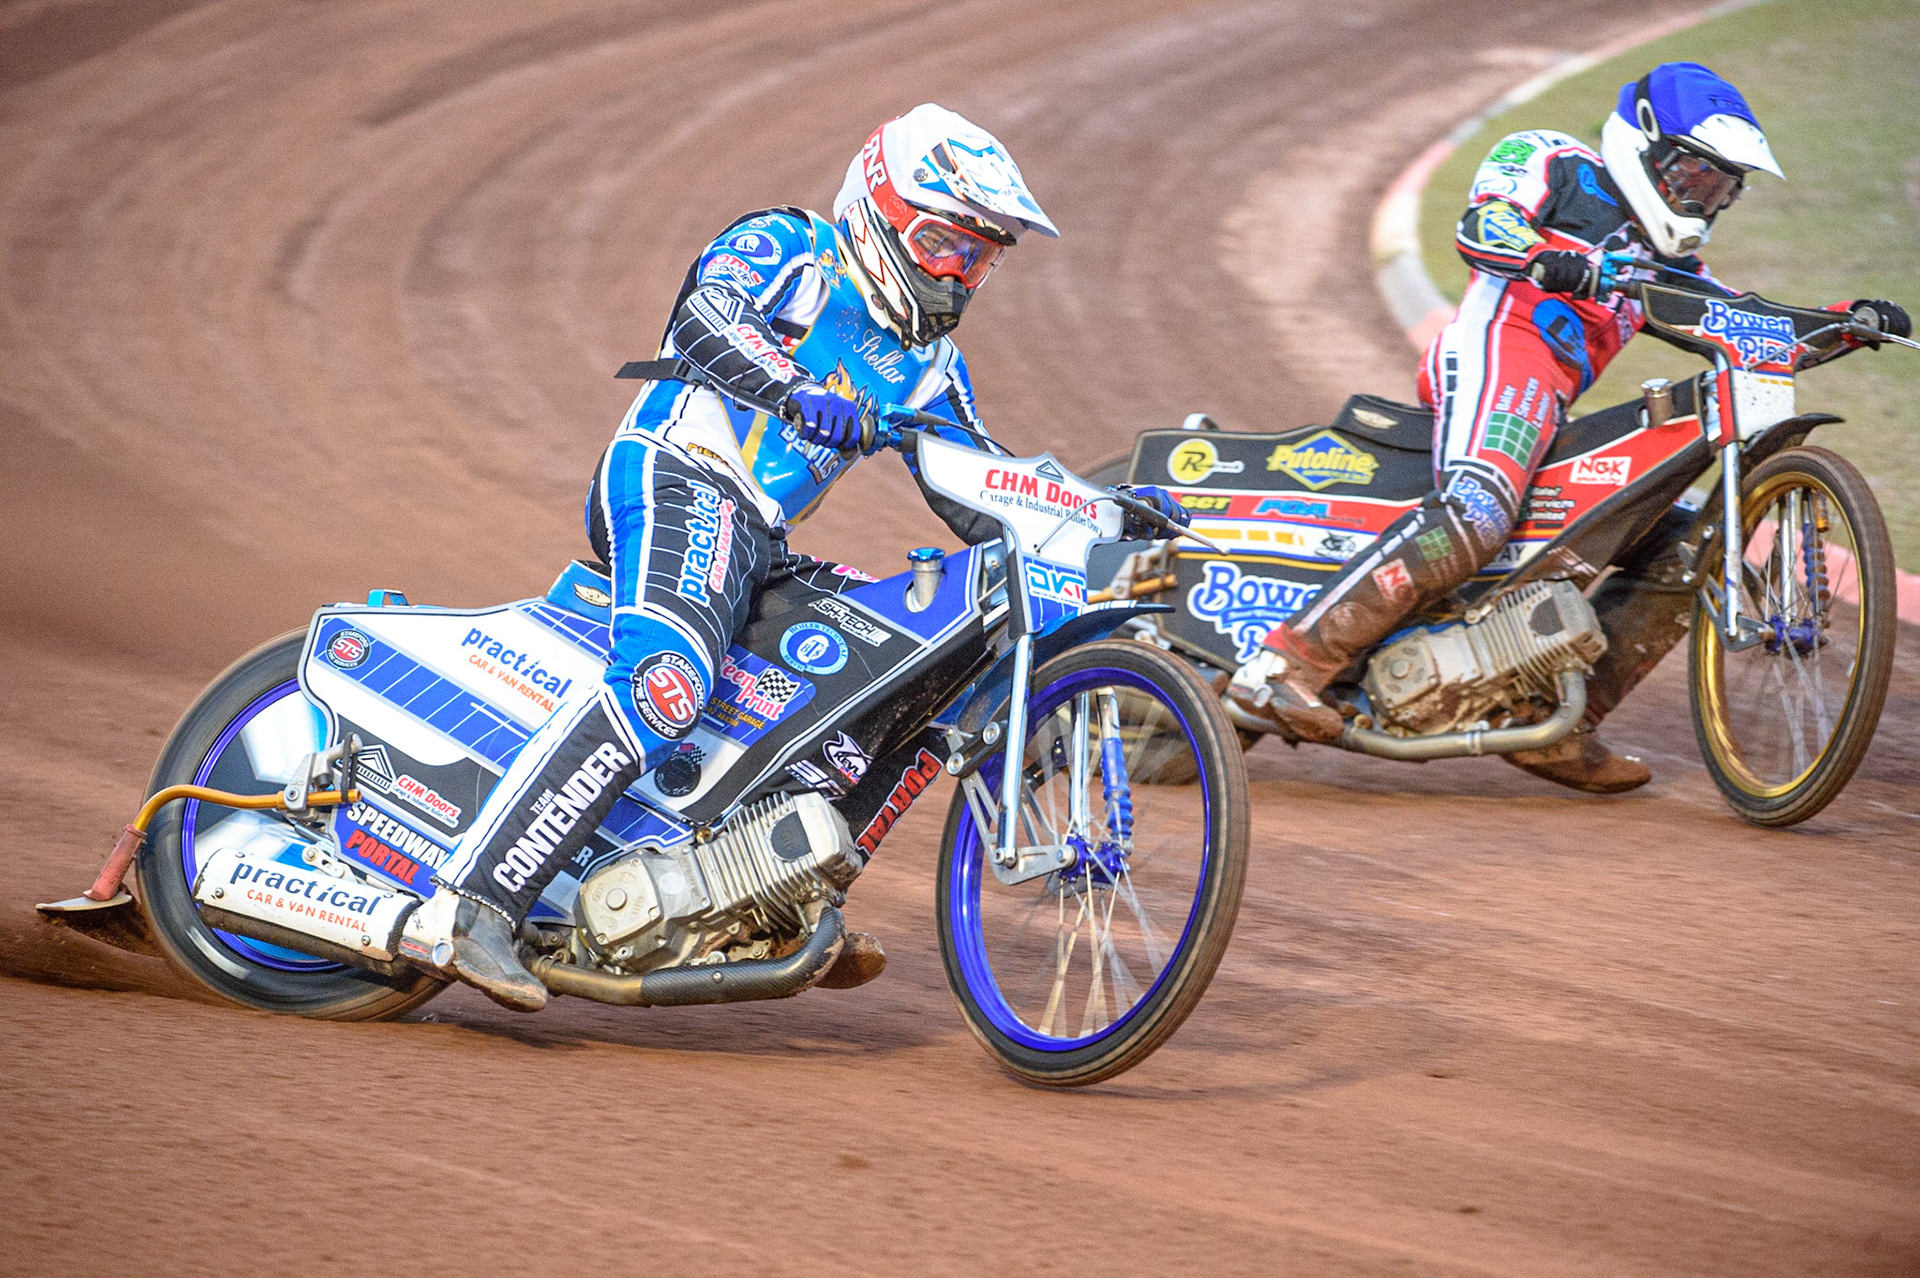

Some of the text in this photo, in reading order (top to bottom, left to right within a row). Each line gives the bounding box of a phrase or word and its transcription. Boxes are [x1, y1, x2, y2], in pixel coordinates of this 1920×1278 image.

[1704, 301, 1794, 336] Bowen
[853, 328, 906, 385] Stellar
[1738, 336, 1788, 362] Pies
[1272, 446, 1375, 473] Putoline
[1578, 459, 1625, 475] NGK
[985, 469, 1039, 498] CHM
[1016, 496, 1024, 508] &
[1025, 498, 1063, 518] Industrial
[679, 480, 720, 606] practical
[332, 638, 363, 659] STS
[461, 627, 573, 699] practical
[469, 654, 489, 670] CAR
[497, 670, 519, 688] VAN
[517, 683, 555, 713] RENTAL
[646, 666, 696, 721] STS
[639, 700, 679, 738] SERVICES
[398, 777, 458, 818] CHM Doors
[493, 741, 632, 893] CONTENDER
[530, 788, 556, 815] TEAM
[856, 750, 942, 855] PORTAL
[344, 829, 421, 886] PORTAL
[346, 801, 451, 871] SPEEDWAY
[229, 862, 382, 916] practical
[247, 889, 367, 933] CAR & VAN RENTAL
